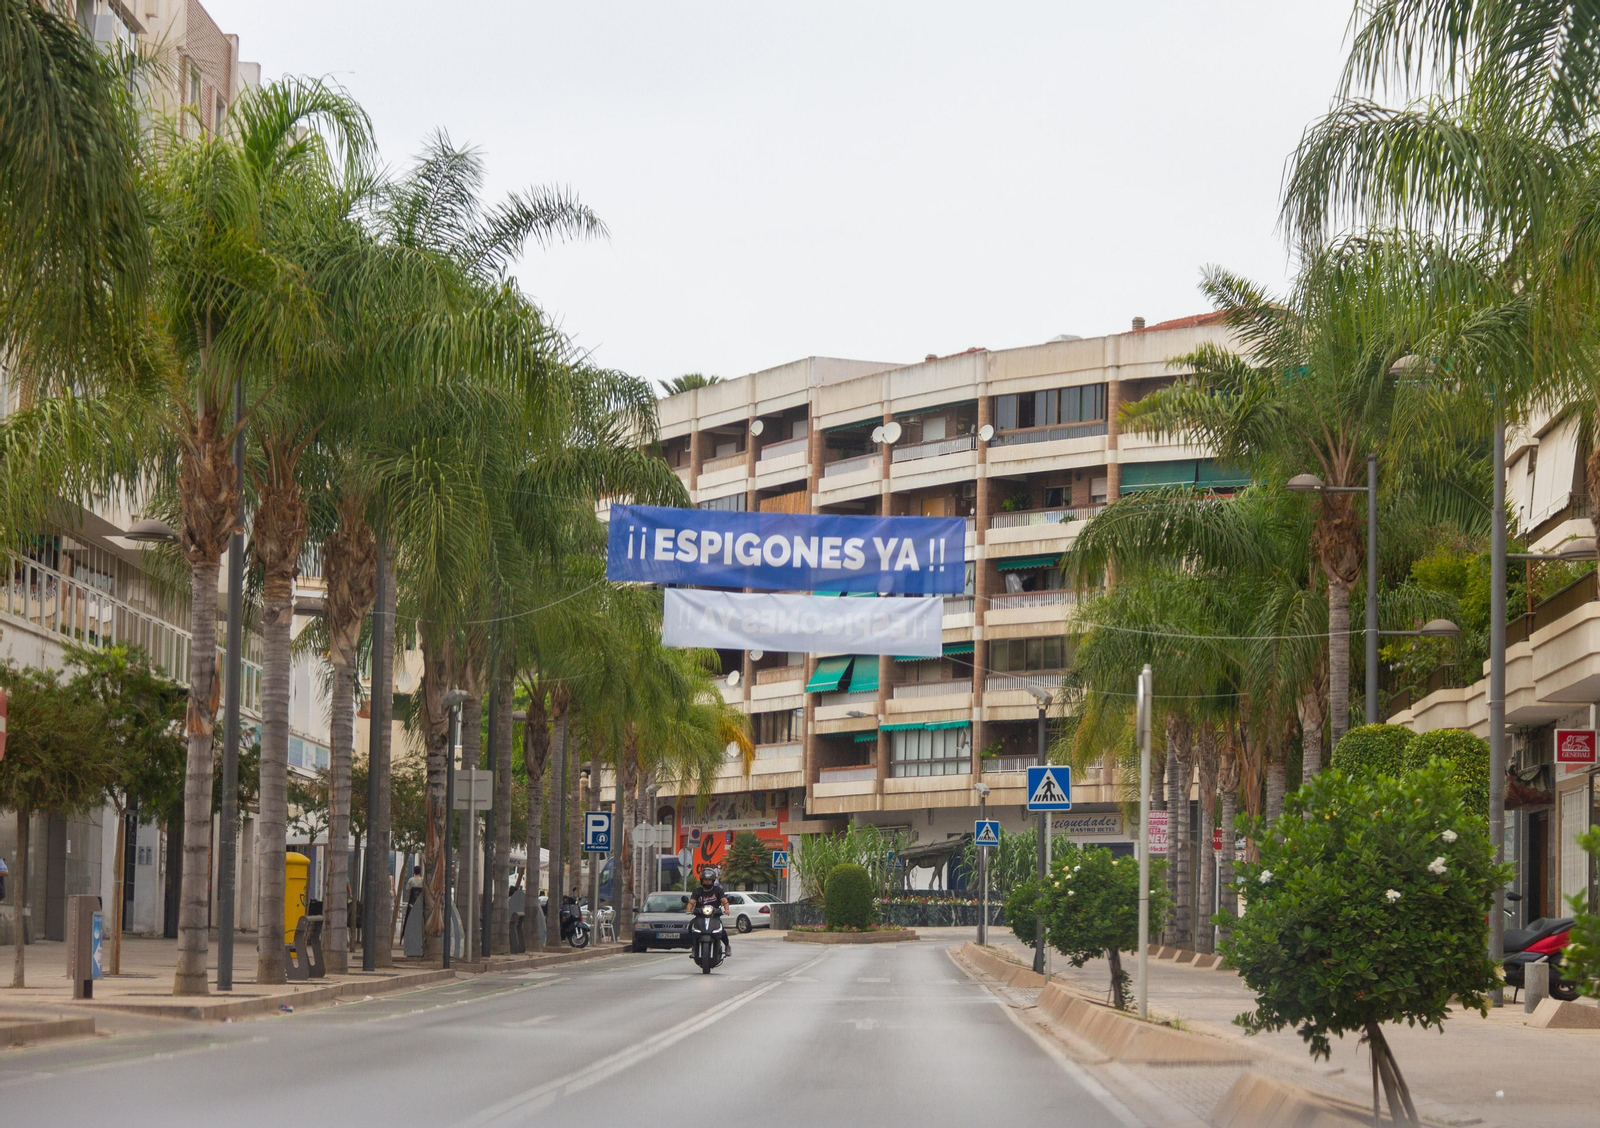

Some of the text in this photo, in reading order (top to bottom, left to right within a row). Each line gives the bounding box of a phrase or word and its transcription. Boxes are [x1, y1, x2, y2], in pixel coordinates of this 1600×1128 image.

[873, 536, 920, 571] YA
[587, 814, 610, 845] P
[1044, 815, 1117, 830] tiguedades
